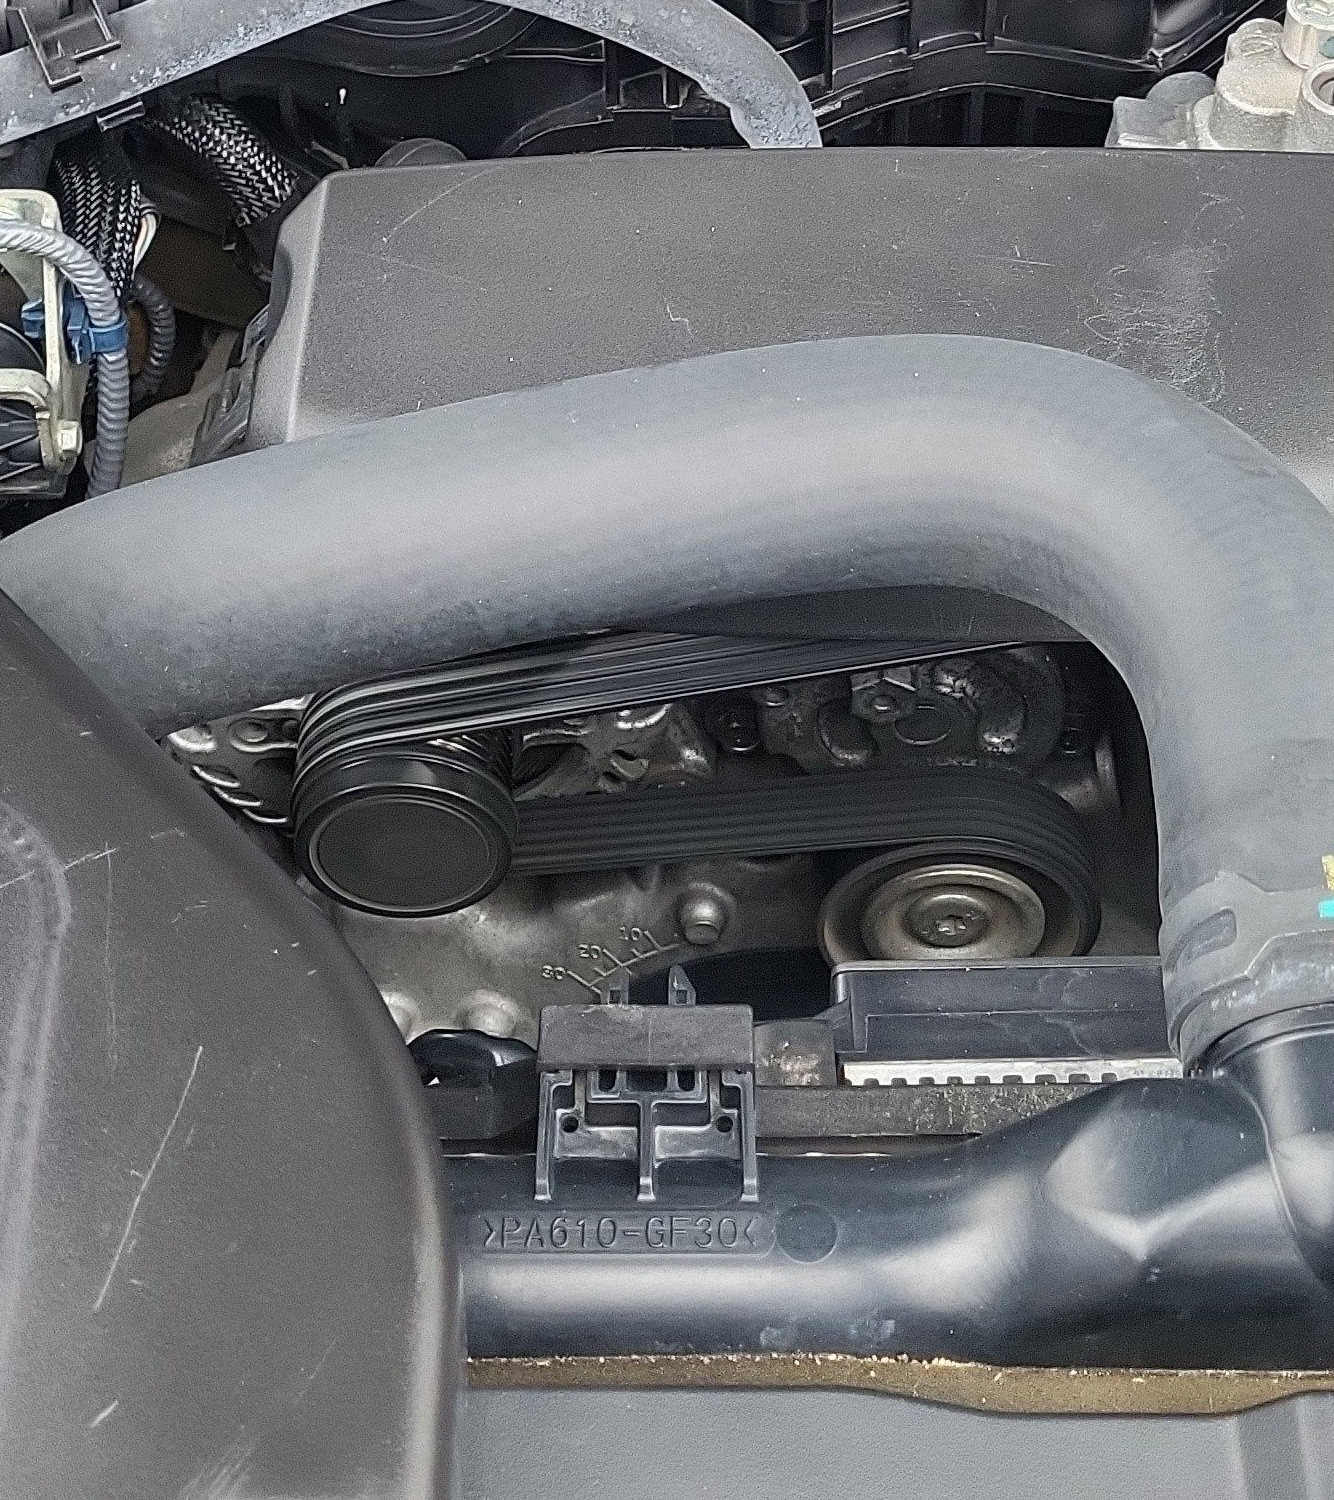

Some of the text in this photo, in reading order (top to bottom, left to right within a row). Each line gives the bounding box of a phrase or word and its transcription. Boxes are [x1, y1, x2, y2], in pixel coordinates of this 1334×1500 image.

[619, 926, 643, 941] 10
[578, 943, 602, 959] 20
[482, 1216, 758, 1249] >PA610-GF30<
